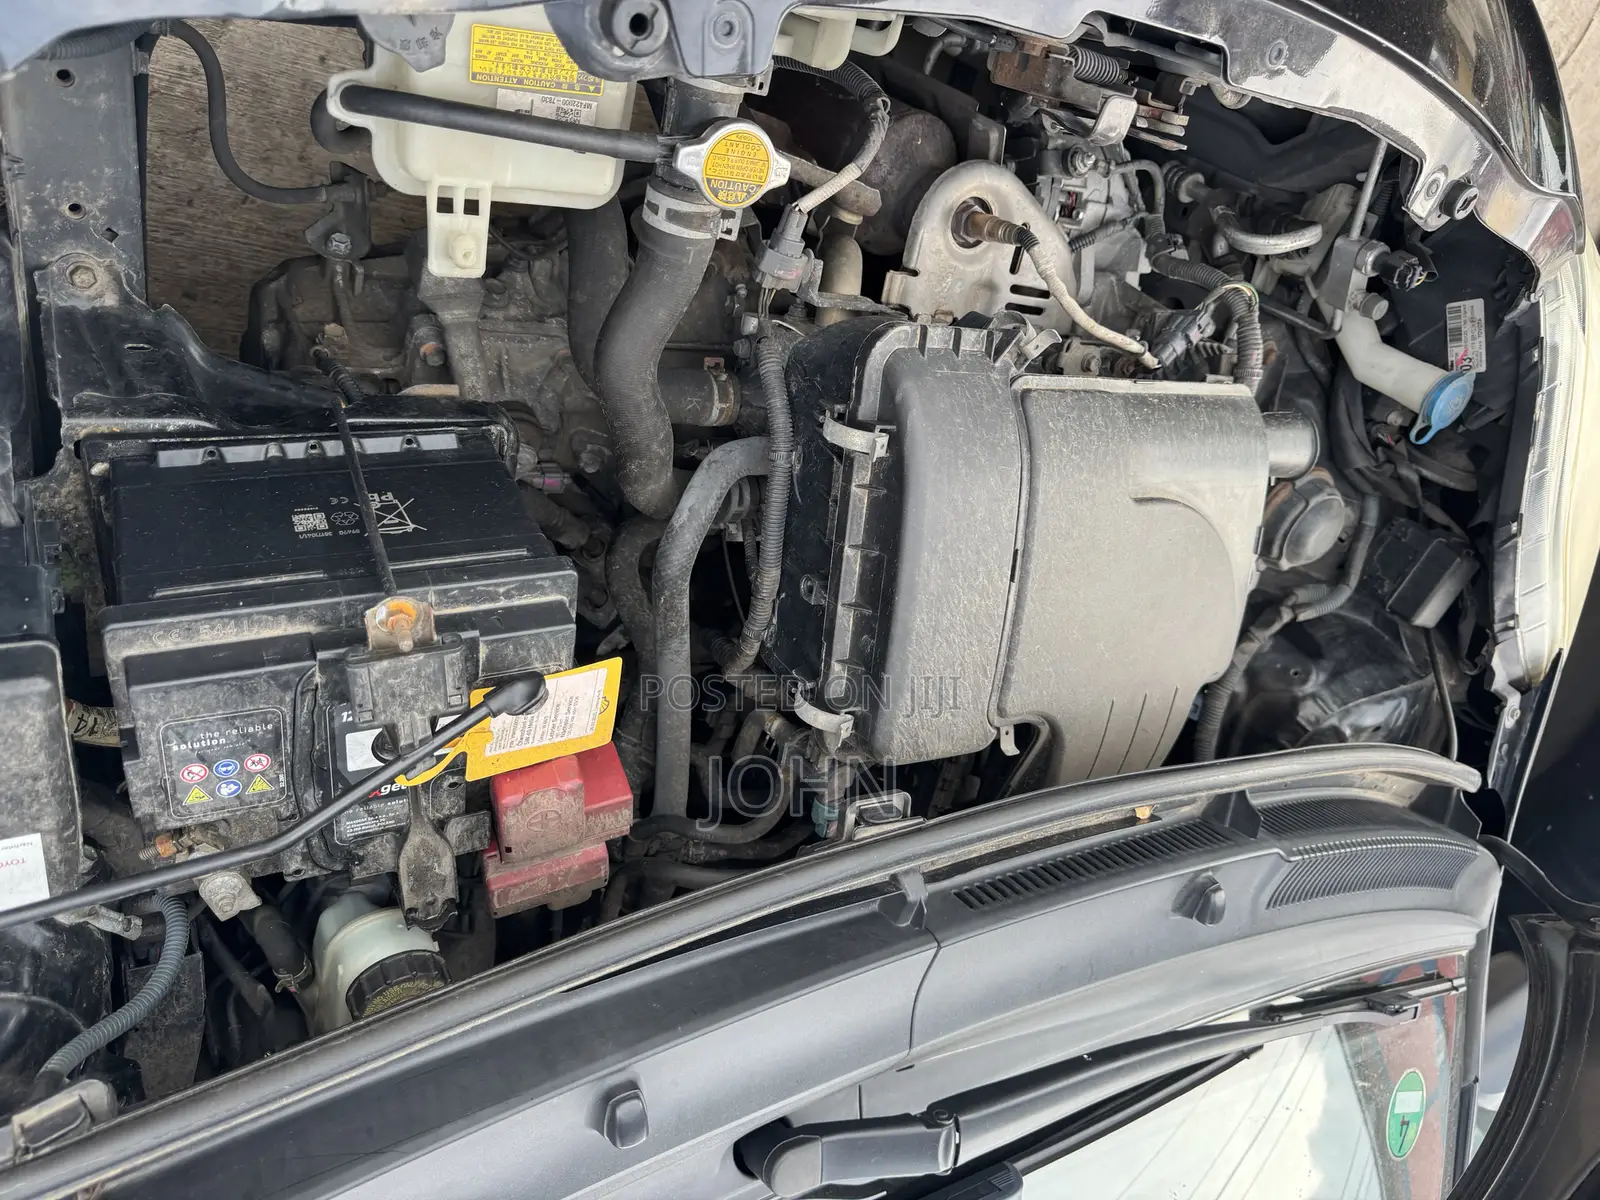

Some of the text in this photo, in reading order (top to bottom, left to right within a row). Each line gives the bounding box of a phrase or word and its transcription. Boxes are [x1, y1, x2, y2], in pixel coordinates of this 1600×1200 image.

[476, 74, 556, 88] CAUTION ATTENTION
[724, 142, 760, 151] COOLANT
[726, 148, 757, 157] ENGINE
[710, 180, 756, 192] CAUTION
[368, 492, 394, 502] Pb
[226, 723, 273, 735] reliable
[172, 738, 225, 751] solution
